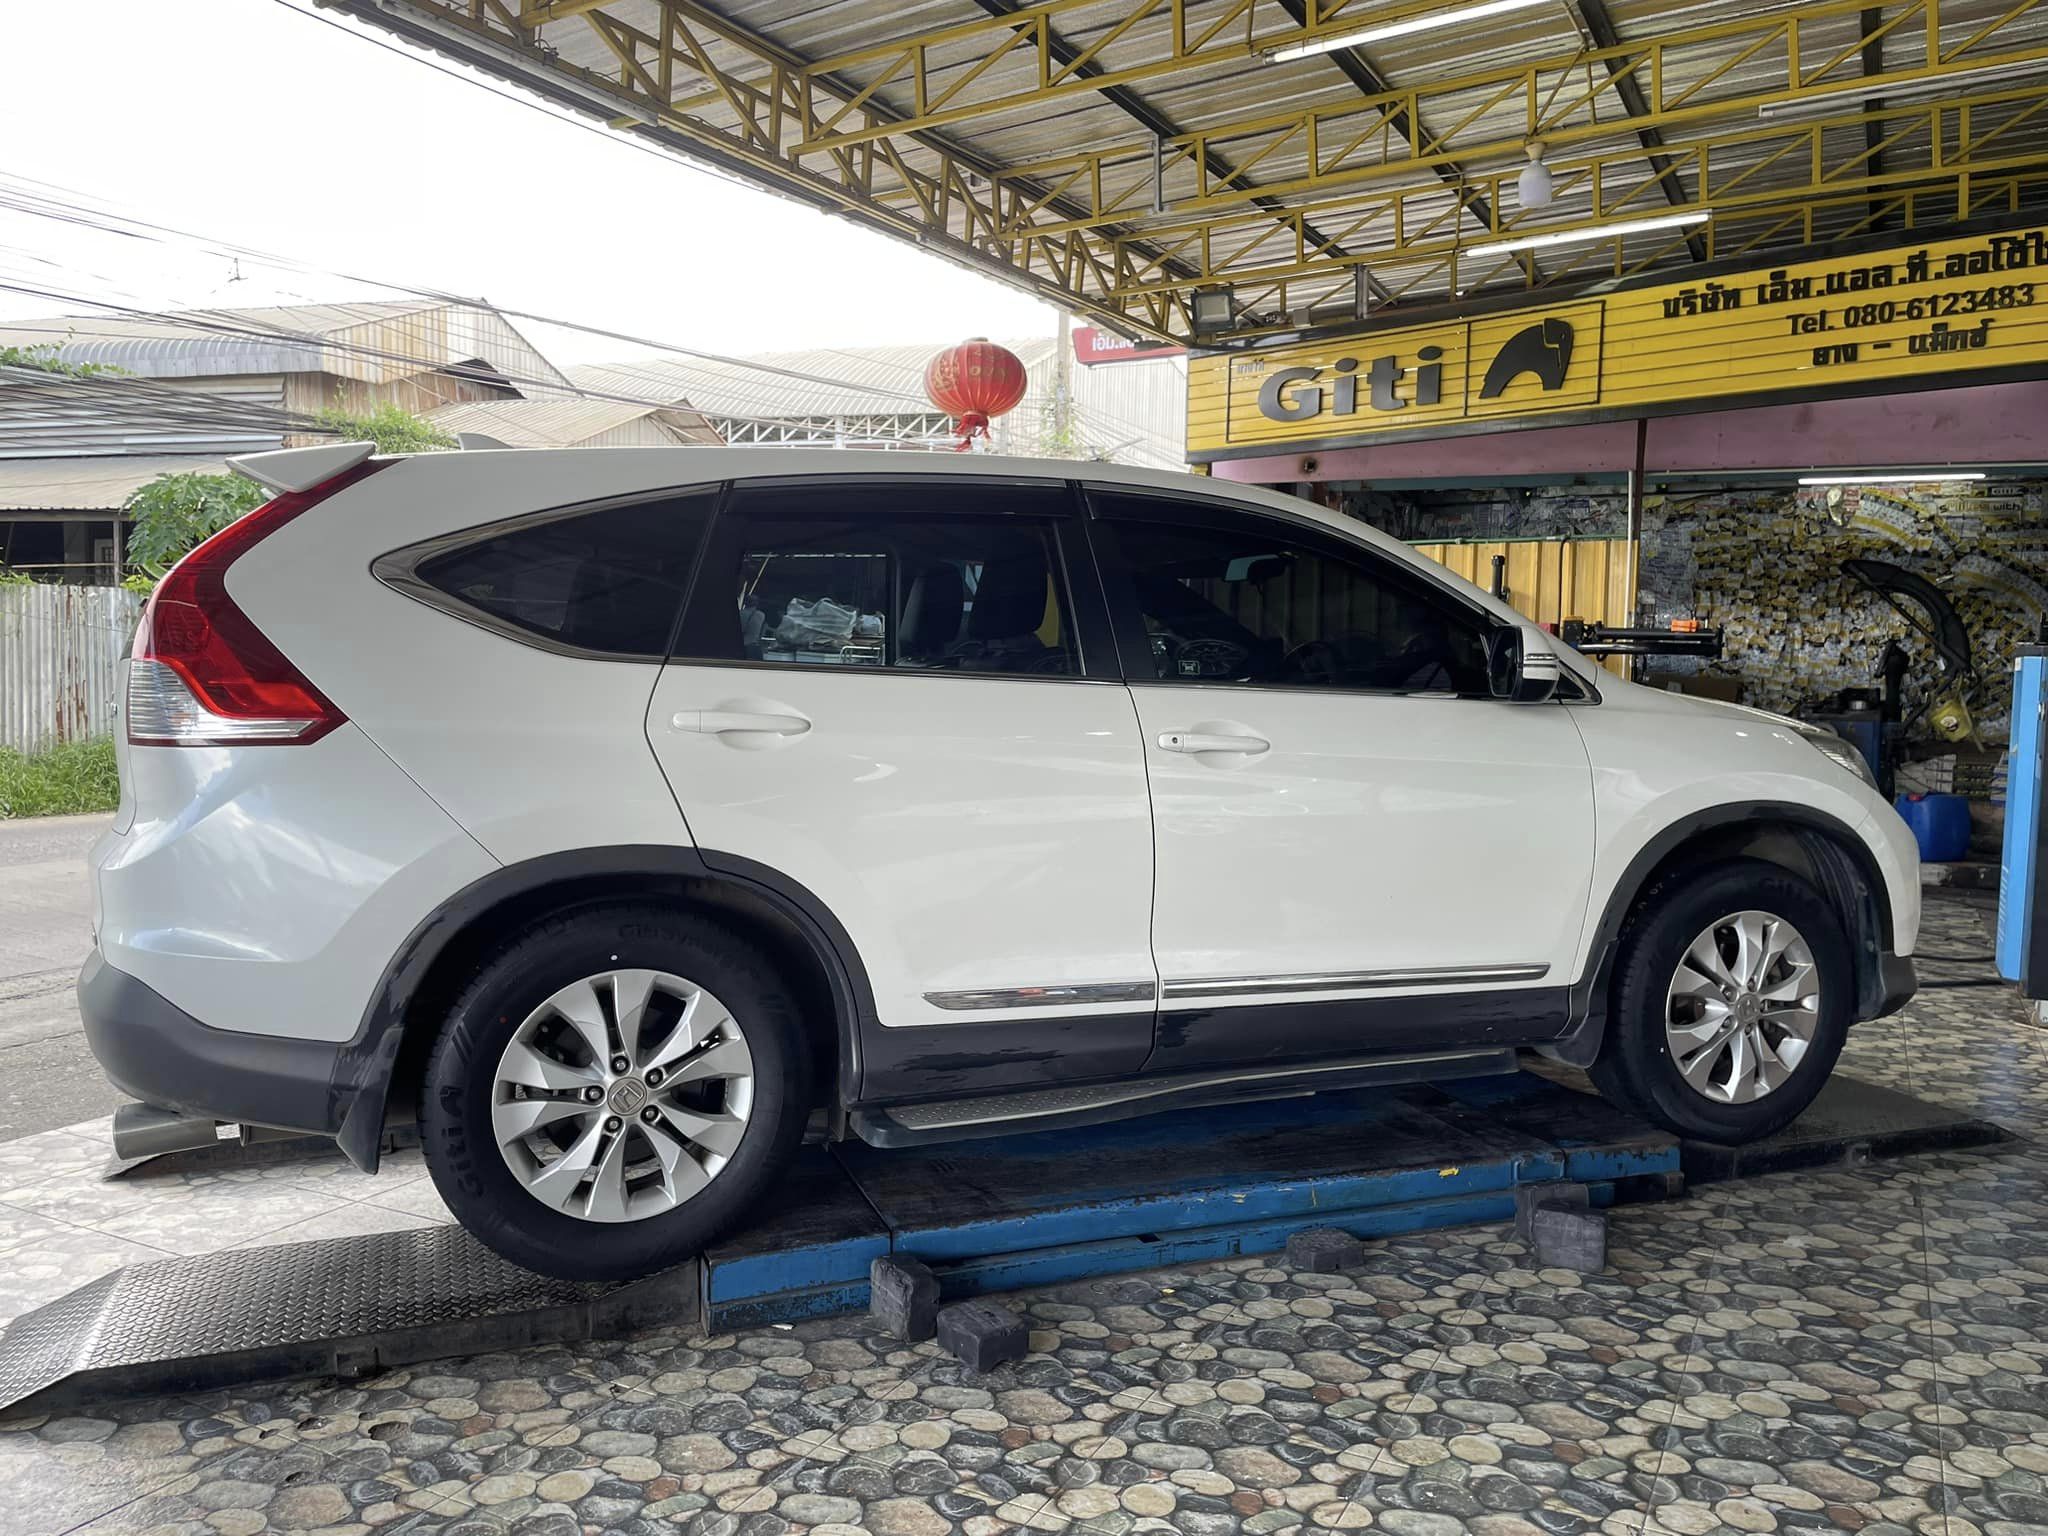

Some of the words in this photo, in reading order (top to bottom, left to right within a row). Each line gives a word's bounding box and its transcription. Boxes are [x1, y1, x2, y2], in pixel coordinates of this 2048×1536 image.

[1663, 282, 1741, 318] บริษัท
[1785, 309, 1834, 336] Tel.
[1843, 283, 2034, 329] 080-6123483
[1812, 342, 1858, 366] ยาง
[1258, 345, 1443, 422] Giti
